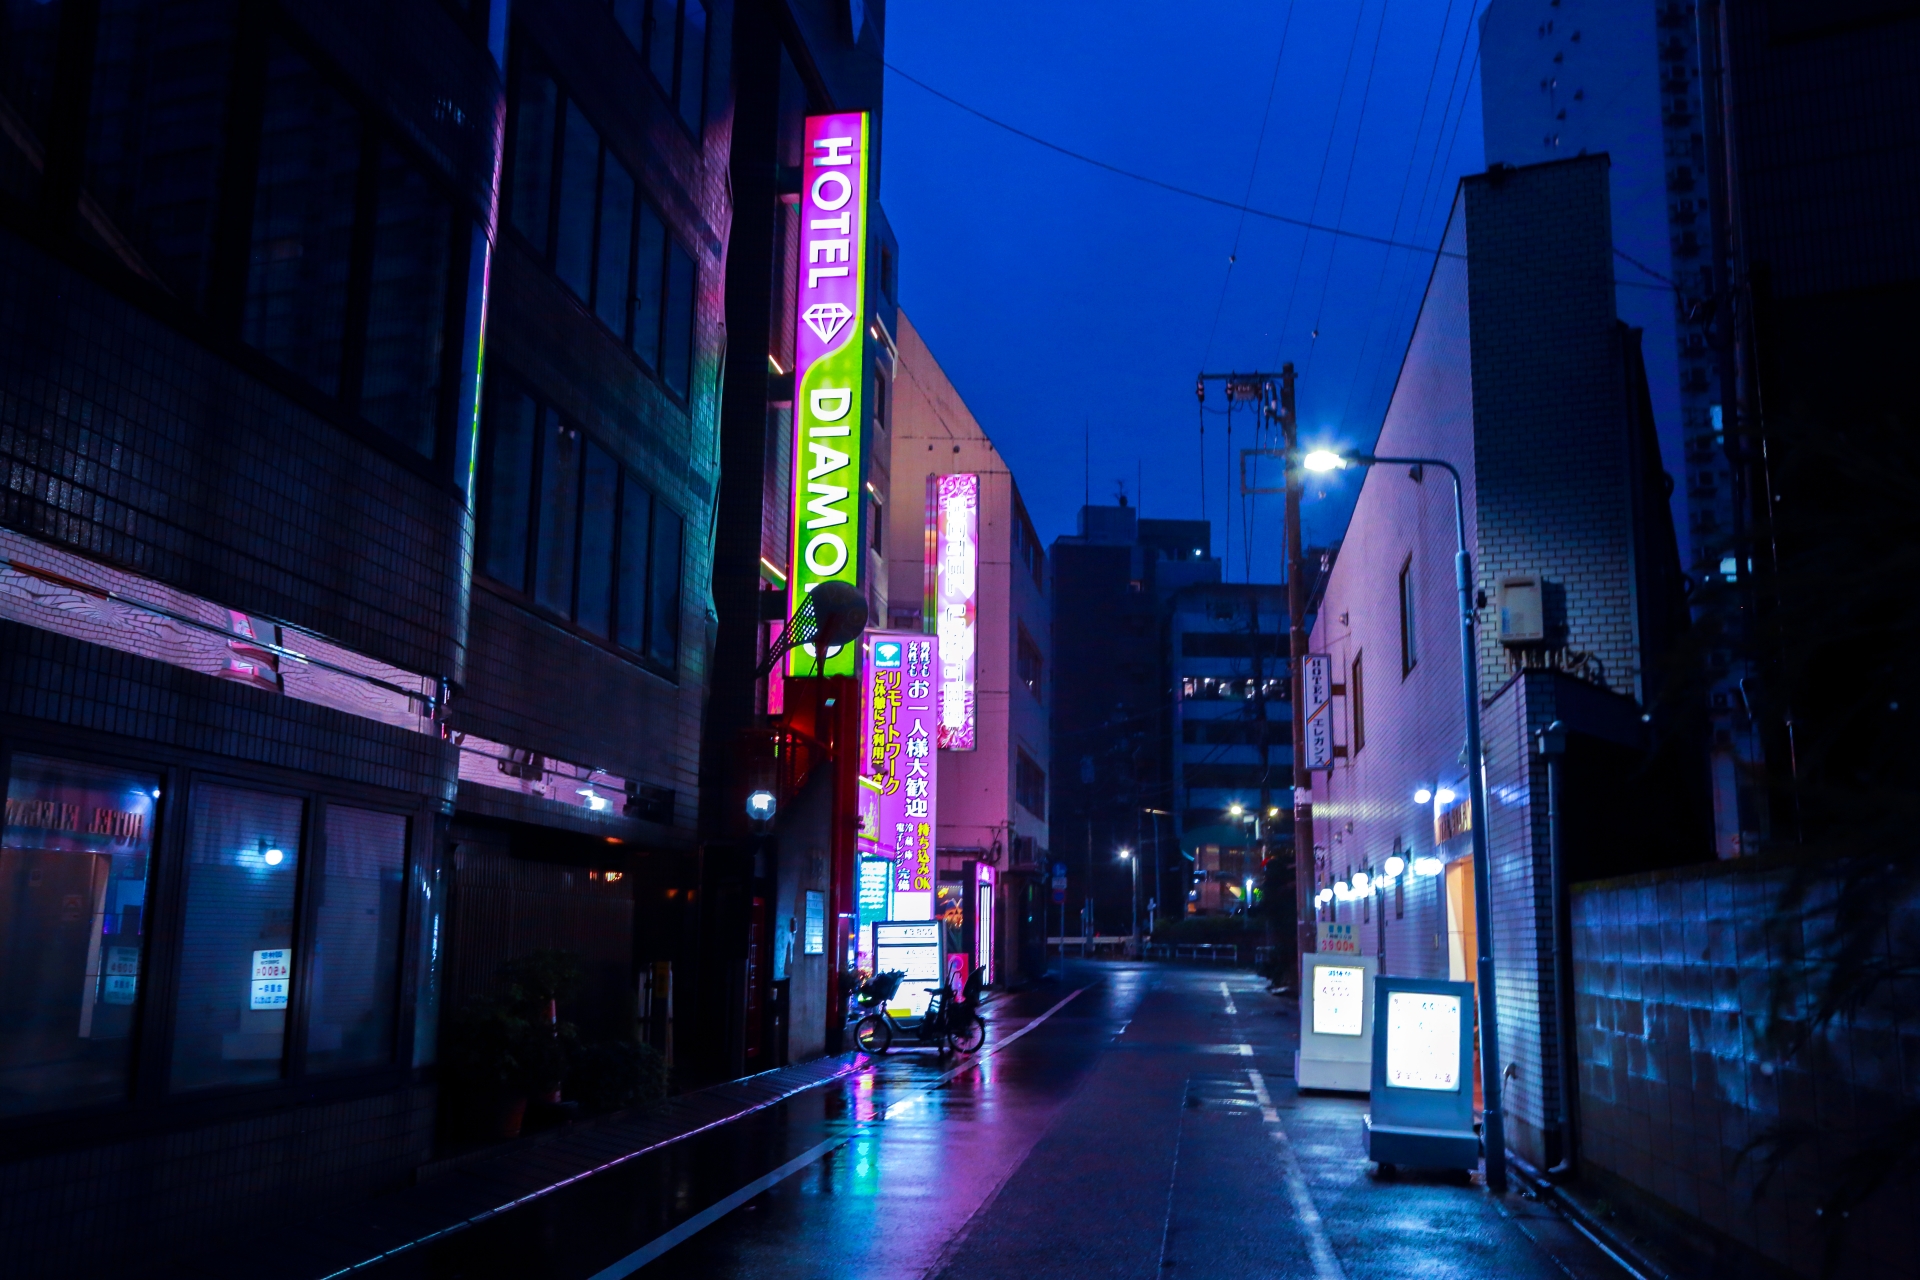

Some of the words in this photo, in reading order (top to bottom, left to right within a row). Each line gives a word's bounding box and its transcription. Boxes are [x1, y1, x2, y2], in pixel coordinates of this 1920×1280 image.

[808, 136, 852, 289] HOTEL
[803, 387, 852, 659] DIAMO
[885, 671, 902, 795] リモートワーク
[1311, 658, 1323, 705] HOTEL
[1312, 718, 1325, 766] エレガンス
[905, 679, 930, 818] お一人様大歓迎
